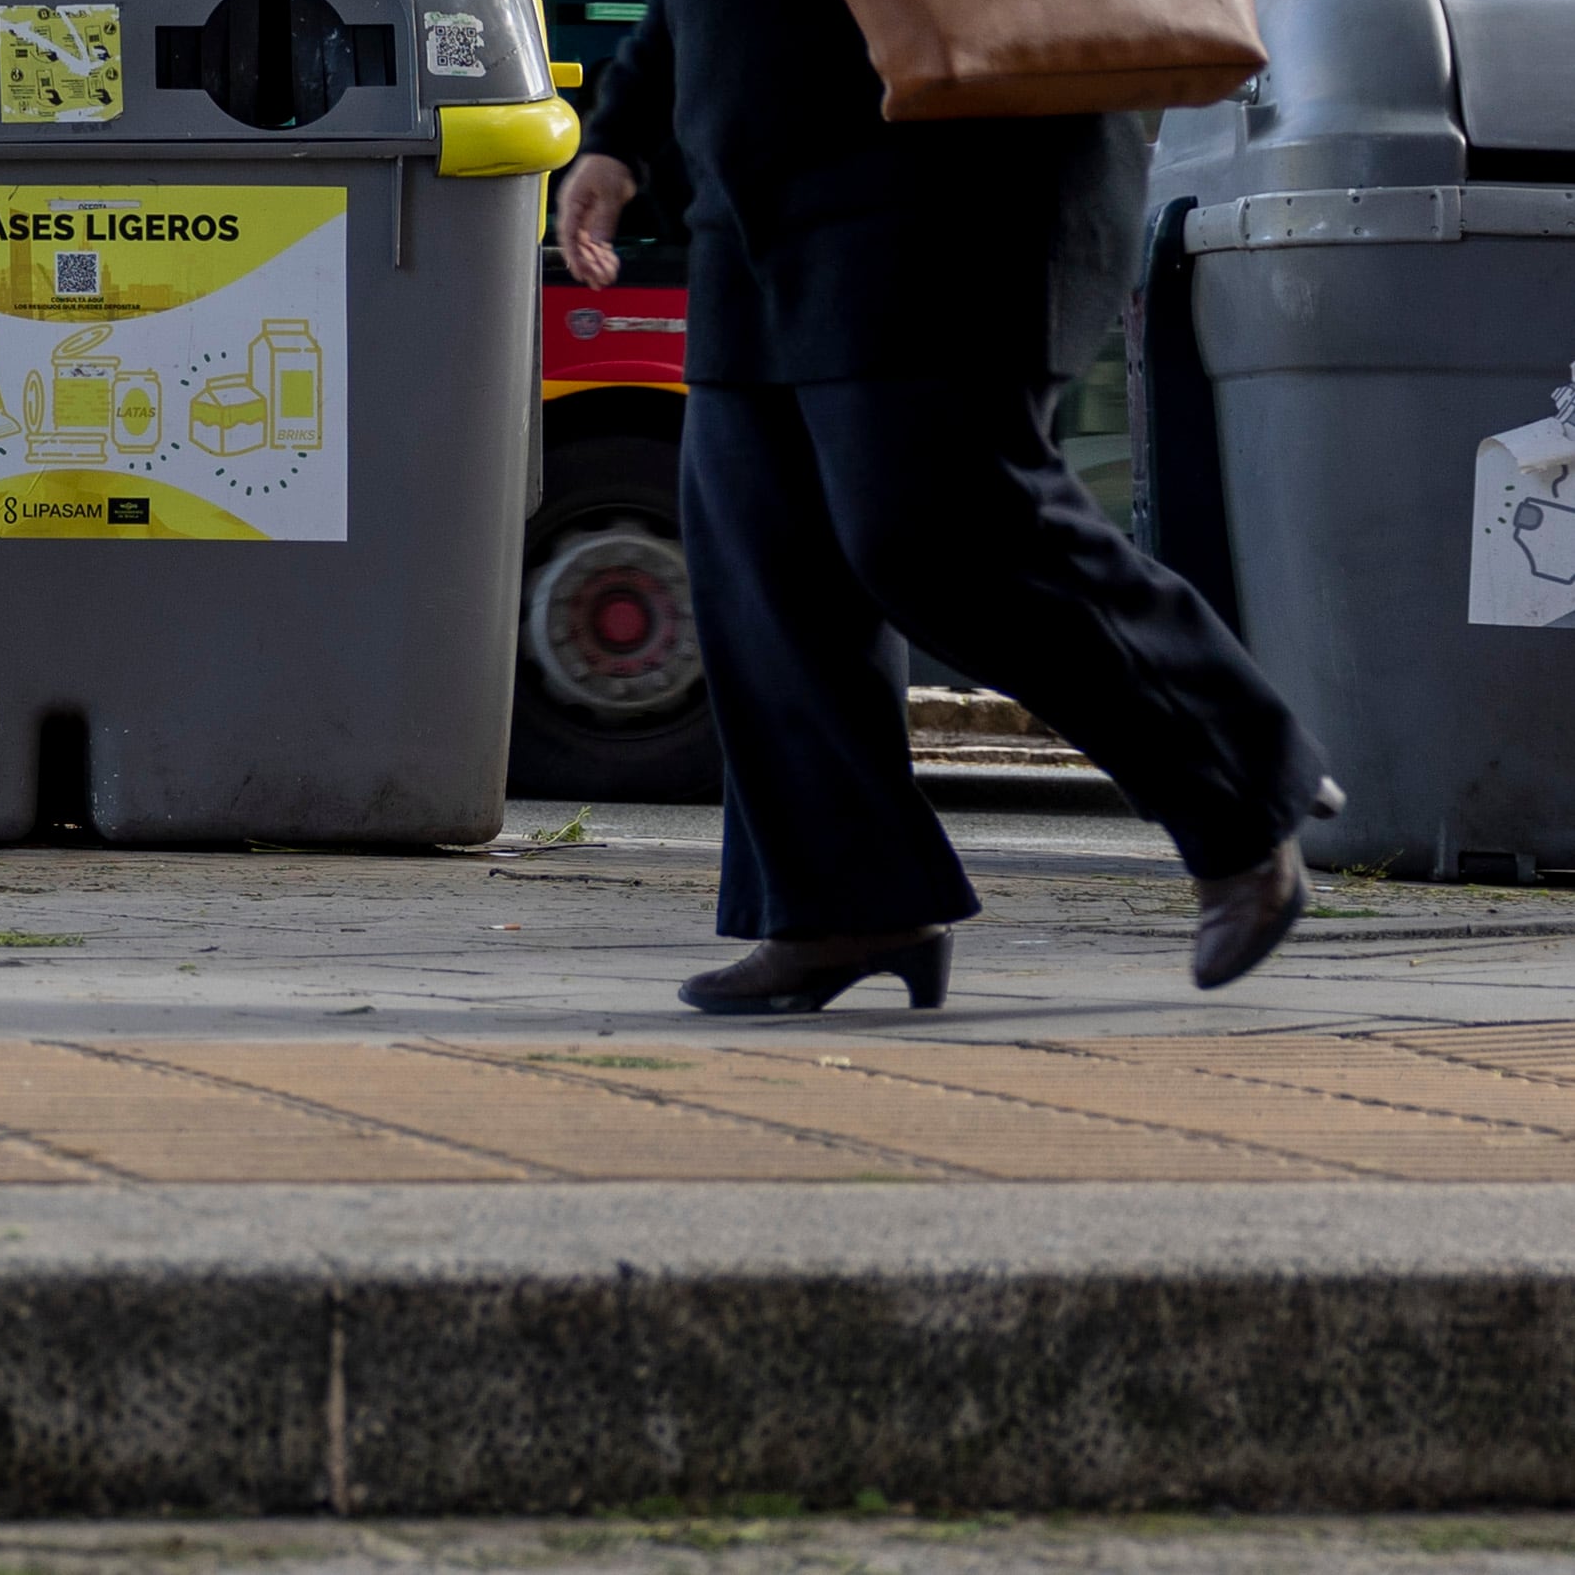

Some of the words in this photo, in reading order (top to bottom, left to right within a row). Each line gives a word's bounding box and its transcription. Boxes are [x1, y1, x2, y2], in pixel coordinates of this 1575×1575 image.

[86, 214, 240, 241] LIGEROS
[116, 407, 156, 418] LATAS
[277, 429, 316, 441] BRIKS
[22, 503, 102, 518] LIPASAM
